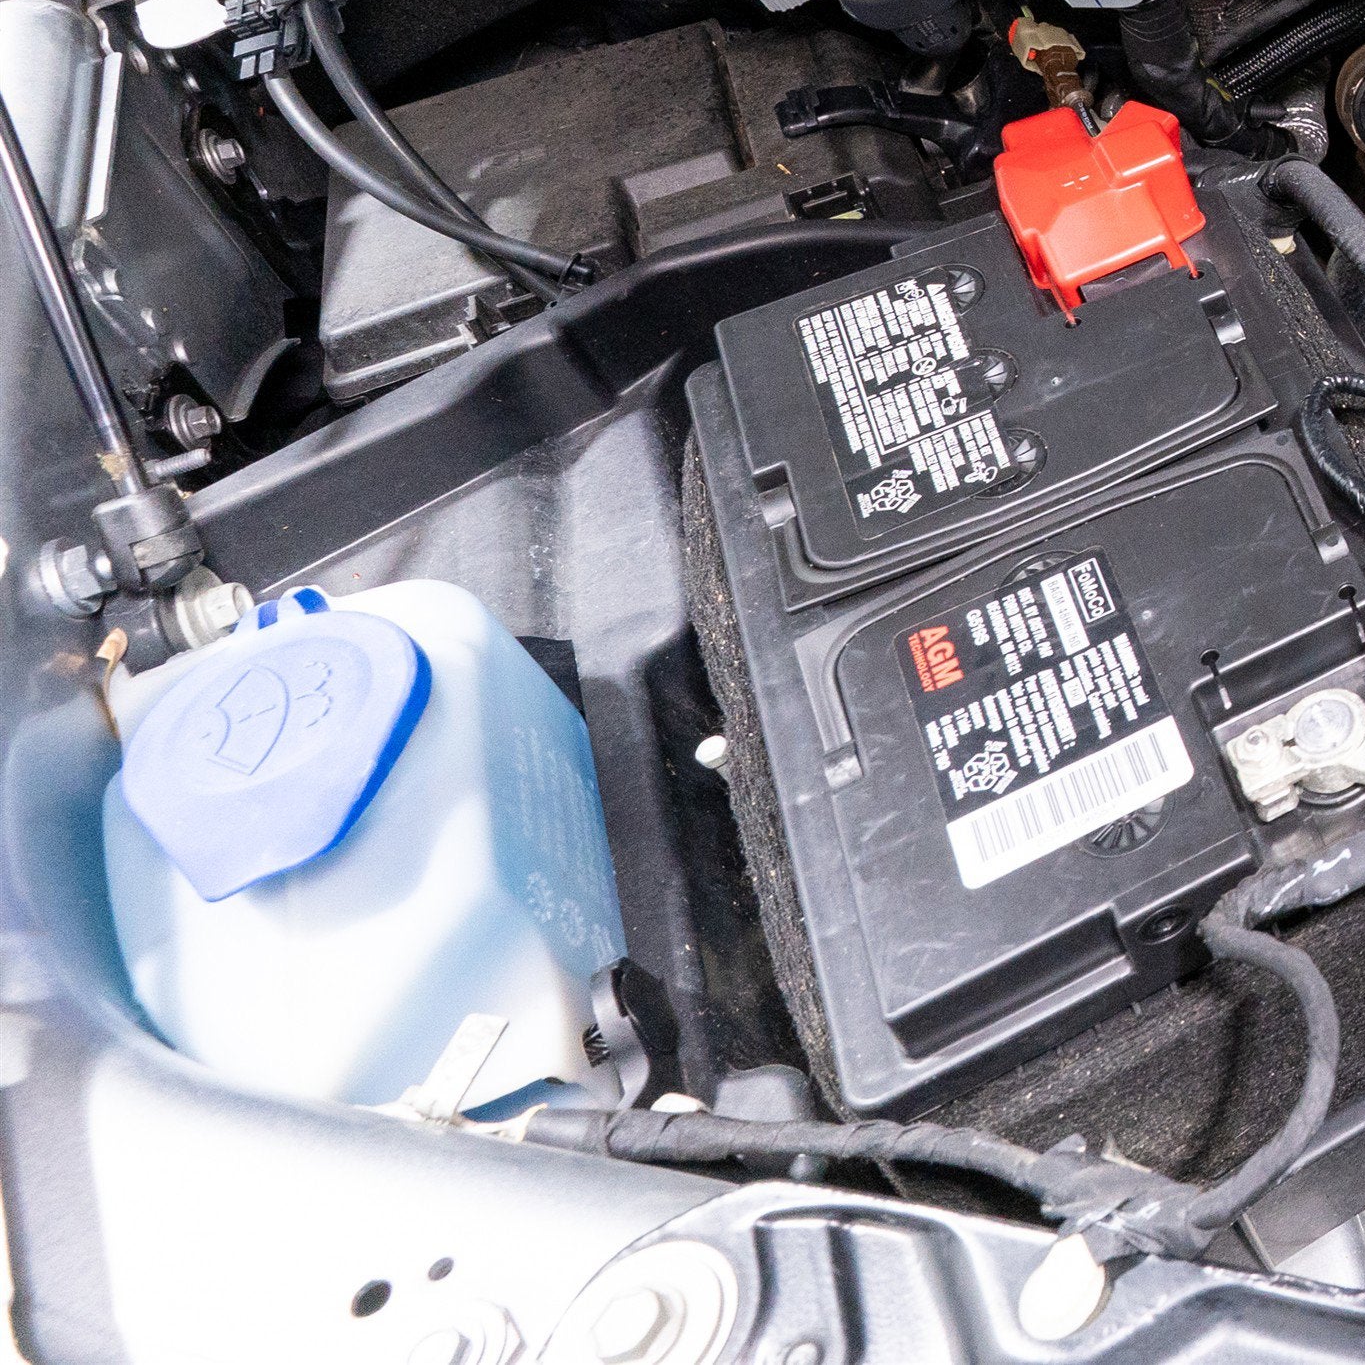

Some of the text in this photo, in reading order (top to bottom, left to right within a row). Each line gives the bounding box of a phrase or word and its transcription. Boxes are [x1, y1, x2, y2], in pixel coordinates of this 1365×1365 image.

[1001, 593, 1019, 616] FORD
[1074, 563, 1108, 618] FoMoCo
[908, 632, 934, 691] TECHNOLOGY
[919, 625, 963, 688] AGM
